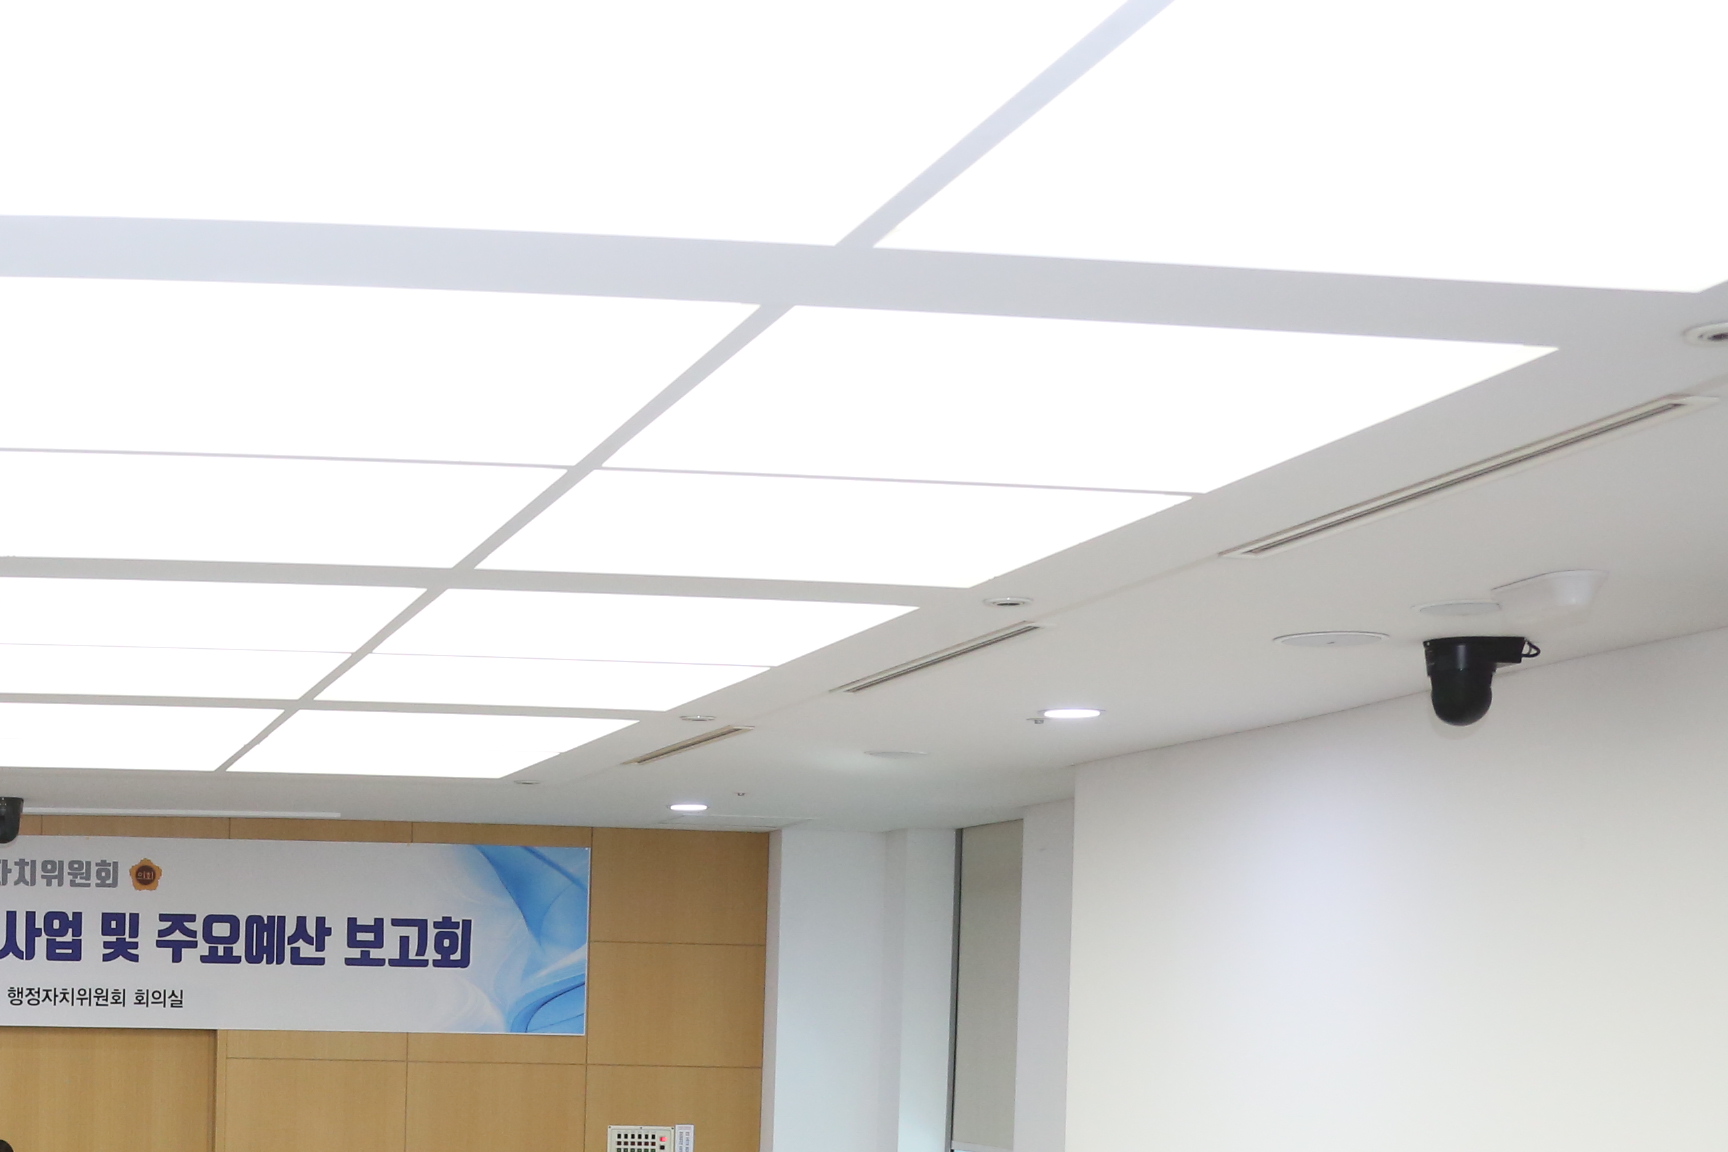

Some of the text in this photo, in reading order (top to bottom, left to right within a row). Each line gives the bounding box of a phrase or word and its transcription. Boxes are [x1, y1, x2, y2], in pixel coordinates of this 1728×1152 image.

[100, 912, 140, 963] 및
[155, 913, 333, 966] 주요예산
[344, 915, 472, 969] 보고회
[7, 986, 126, 1008] 행정자치위원회
[133, 988, 184, 1009] 회의실
